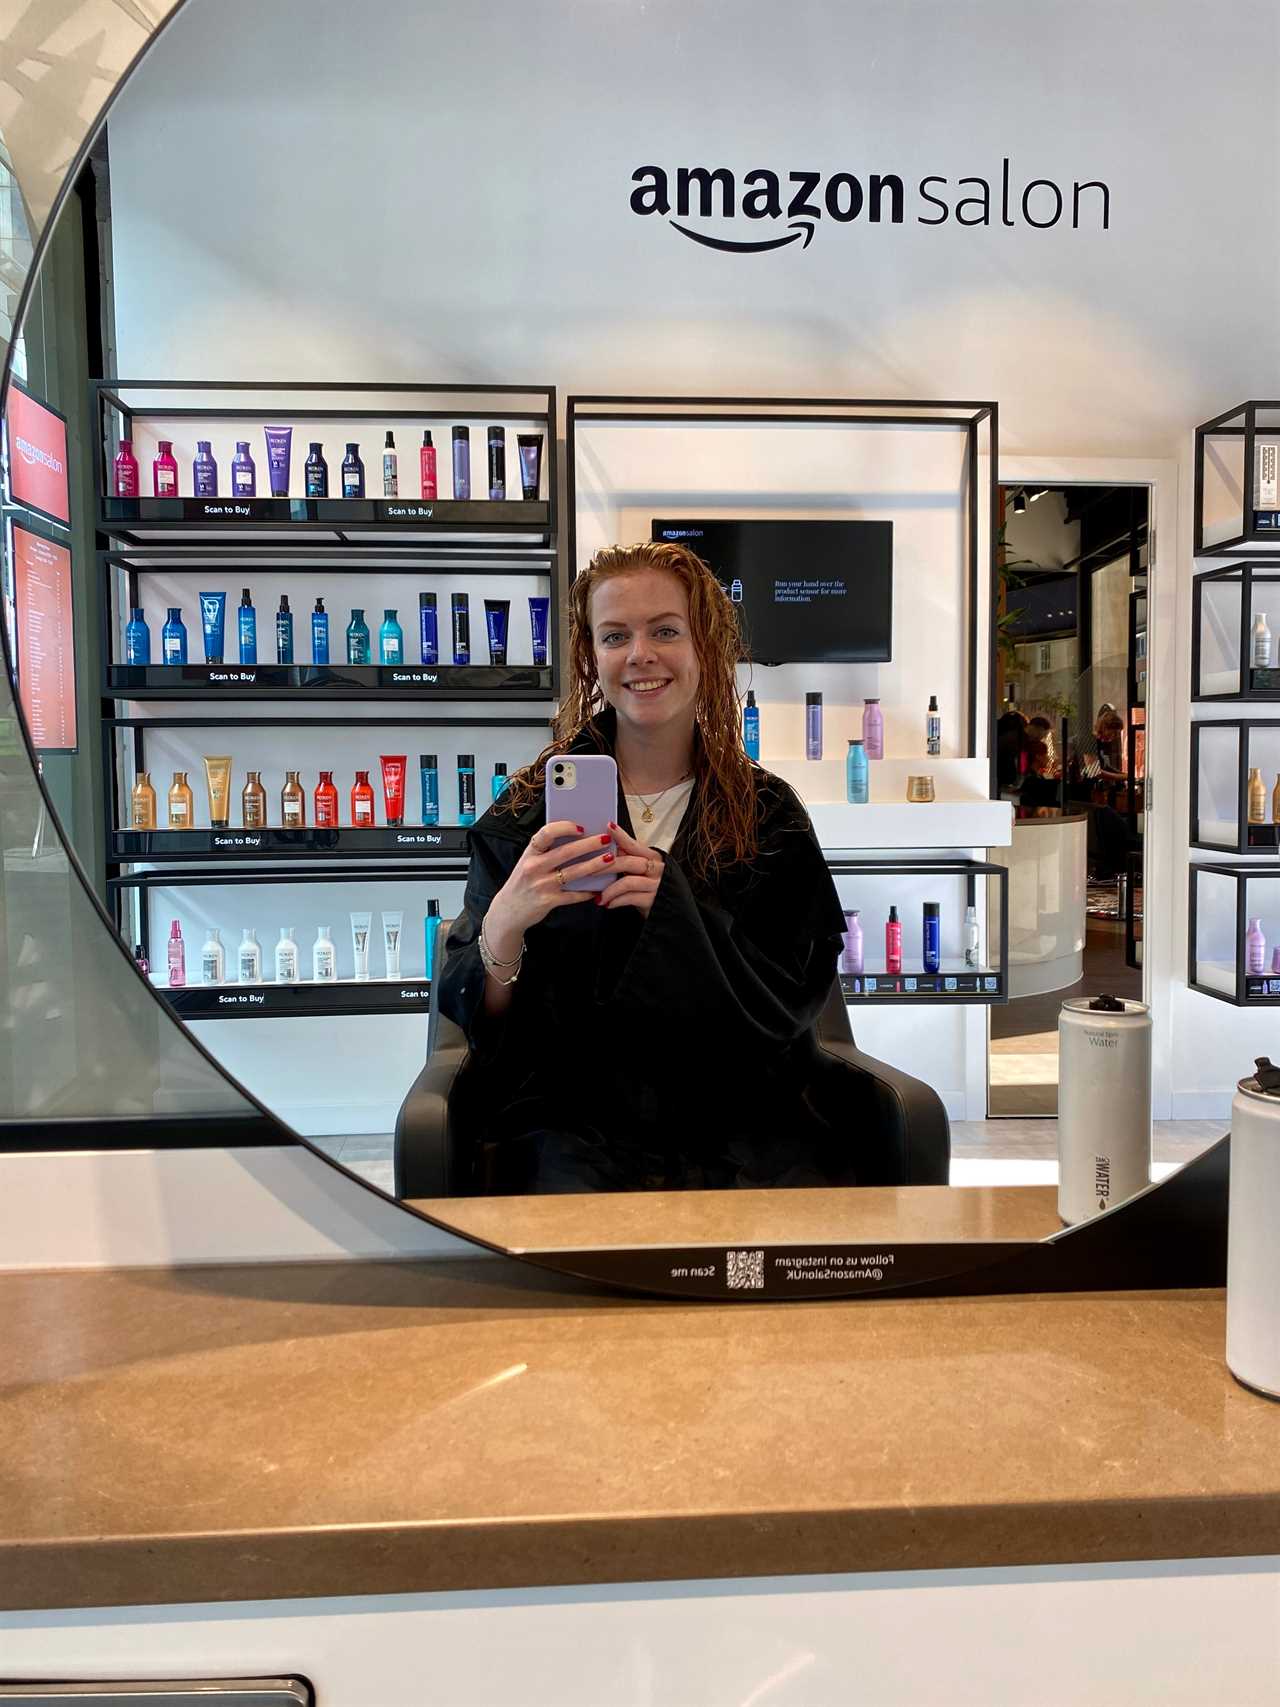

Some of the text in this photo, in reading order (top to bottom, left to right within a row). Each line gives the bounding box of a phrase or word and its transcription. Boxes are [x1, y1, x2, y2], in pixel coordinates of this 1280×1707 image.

[204, 505, 250, 515] Scan to Buy
[388, 507, 406, 515] Scan
[418, 507, 433, 517] Buy
[775, 587, 799, 595] product
[209, 672, 256, 682] Scan to Buy
[392, 673, 438, 683] Scan to Buy
[214, 837, 233, 845] Scan
[245, 837, 261, 846] Buy
[397, 834, 415, 843] Scan
[426, 834, 441, 844] Buy
[218, 995, 237, 1003] Scan
[249, 994, 265, 1004] Buy
[400, 990, 429, 998] Scan to
[1088, 1037, 1118, 1048] Water
[1095, 1163, 1110, 1197] WATER
